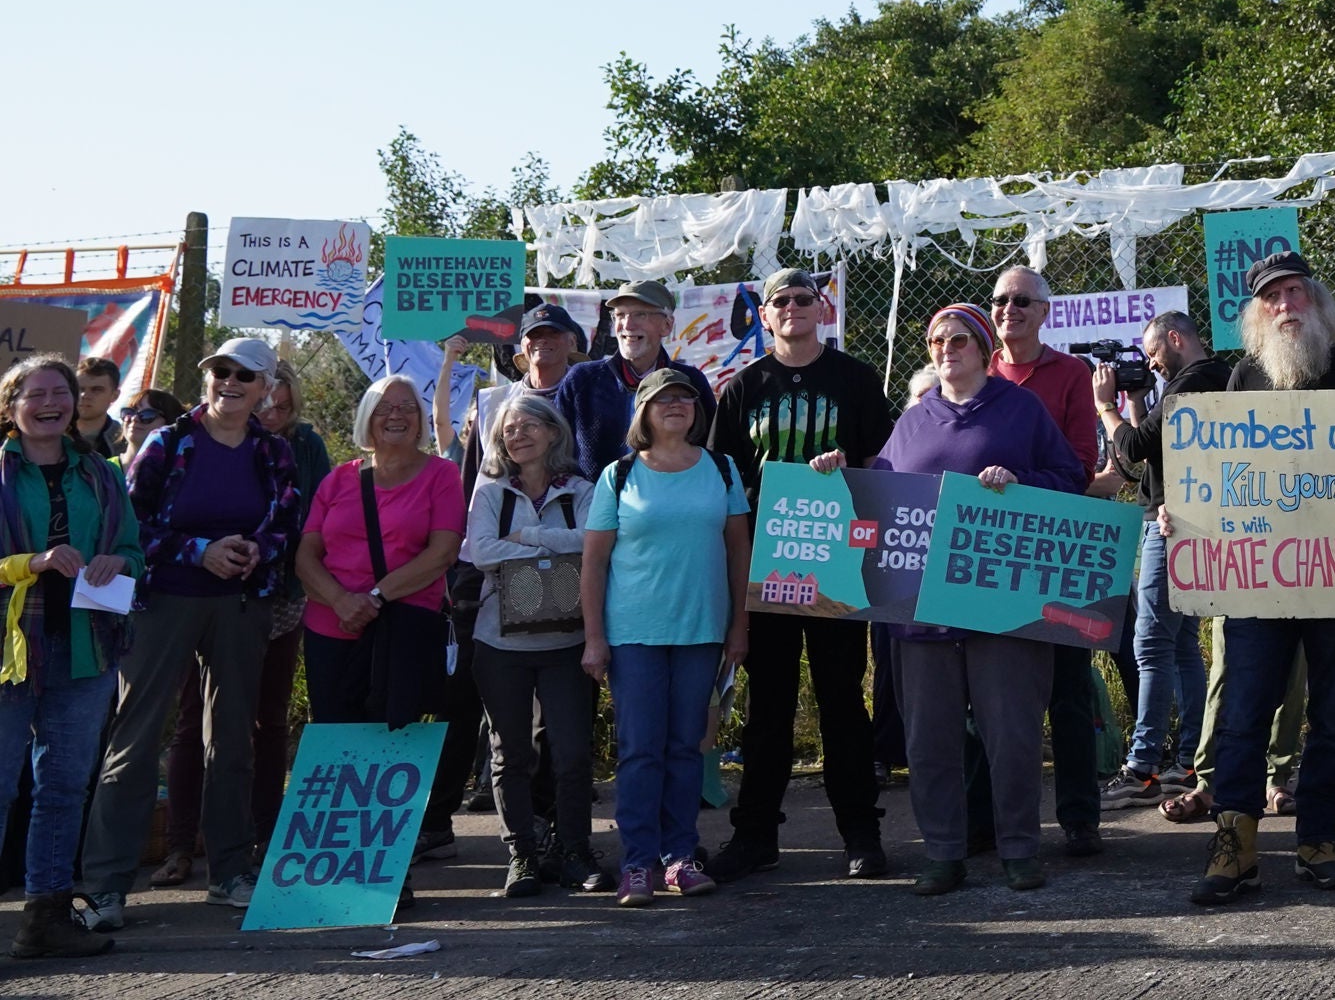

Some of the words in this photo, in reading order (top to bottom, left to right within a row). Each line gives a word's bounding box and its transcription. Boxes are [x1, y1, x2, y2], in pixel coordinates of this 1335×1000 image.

[240, 234, 271, 248] THIS
[279, 237, 291, 248] IS
[298, 236, 309, 248] A
[232, 259, 315, 277] CLIMATE
[397, 257, 512, 270] WHITEHAVEN
[397, 272, 512, 289] DESERVES
[231, 287, 342, 311] EMERGENCY
[397, 290, 512, 312] BETTER
[1169, 407, 1316, 450] Dumbest
[1179, 467, 1212, 503] to
[1220, 462, 1272, 507] Kill
[773, 497, 841, 519] 4,500
[766, 518, 843, 541] GREEN
[853, 527, 875, 541] or
[956, 504, 1121, 543] WHITEHAVEN
[1221, 517, 1235, 533] is
[1242, 517, 1272, 533] with
[884, 528, 931, 549] COA
[950, 527, 1117, 570] DESERVES
[772, 541, 831, 562] JOBS
[1168, 537, 1268, 591] CLIMATE
[945, 553, 1114, 600] BETTER
[297, 763, 421, 808] #NO
[282, 809, 413, 849] NEW
[272, 850, 394, 887] COAL
